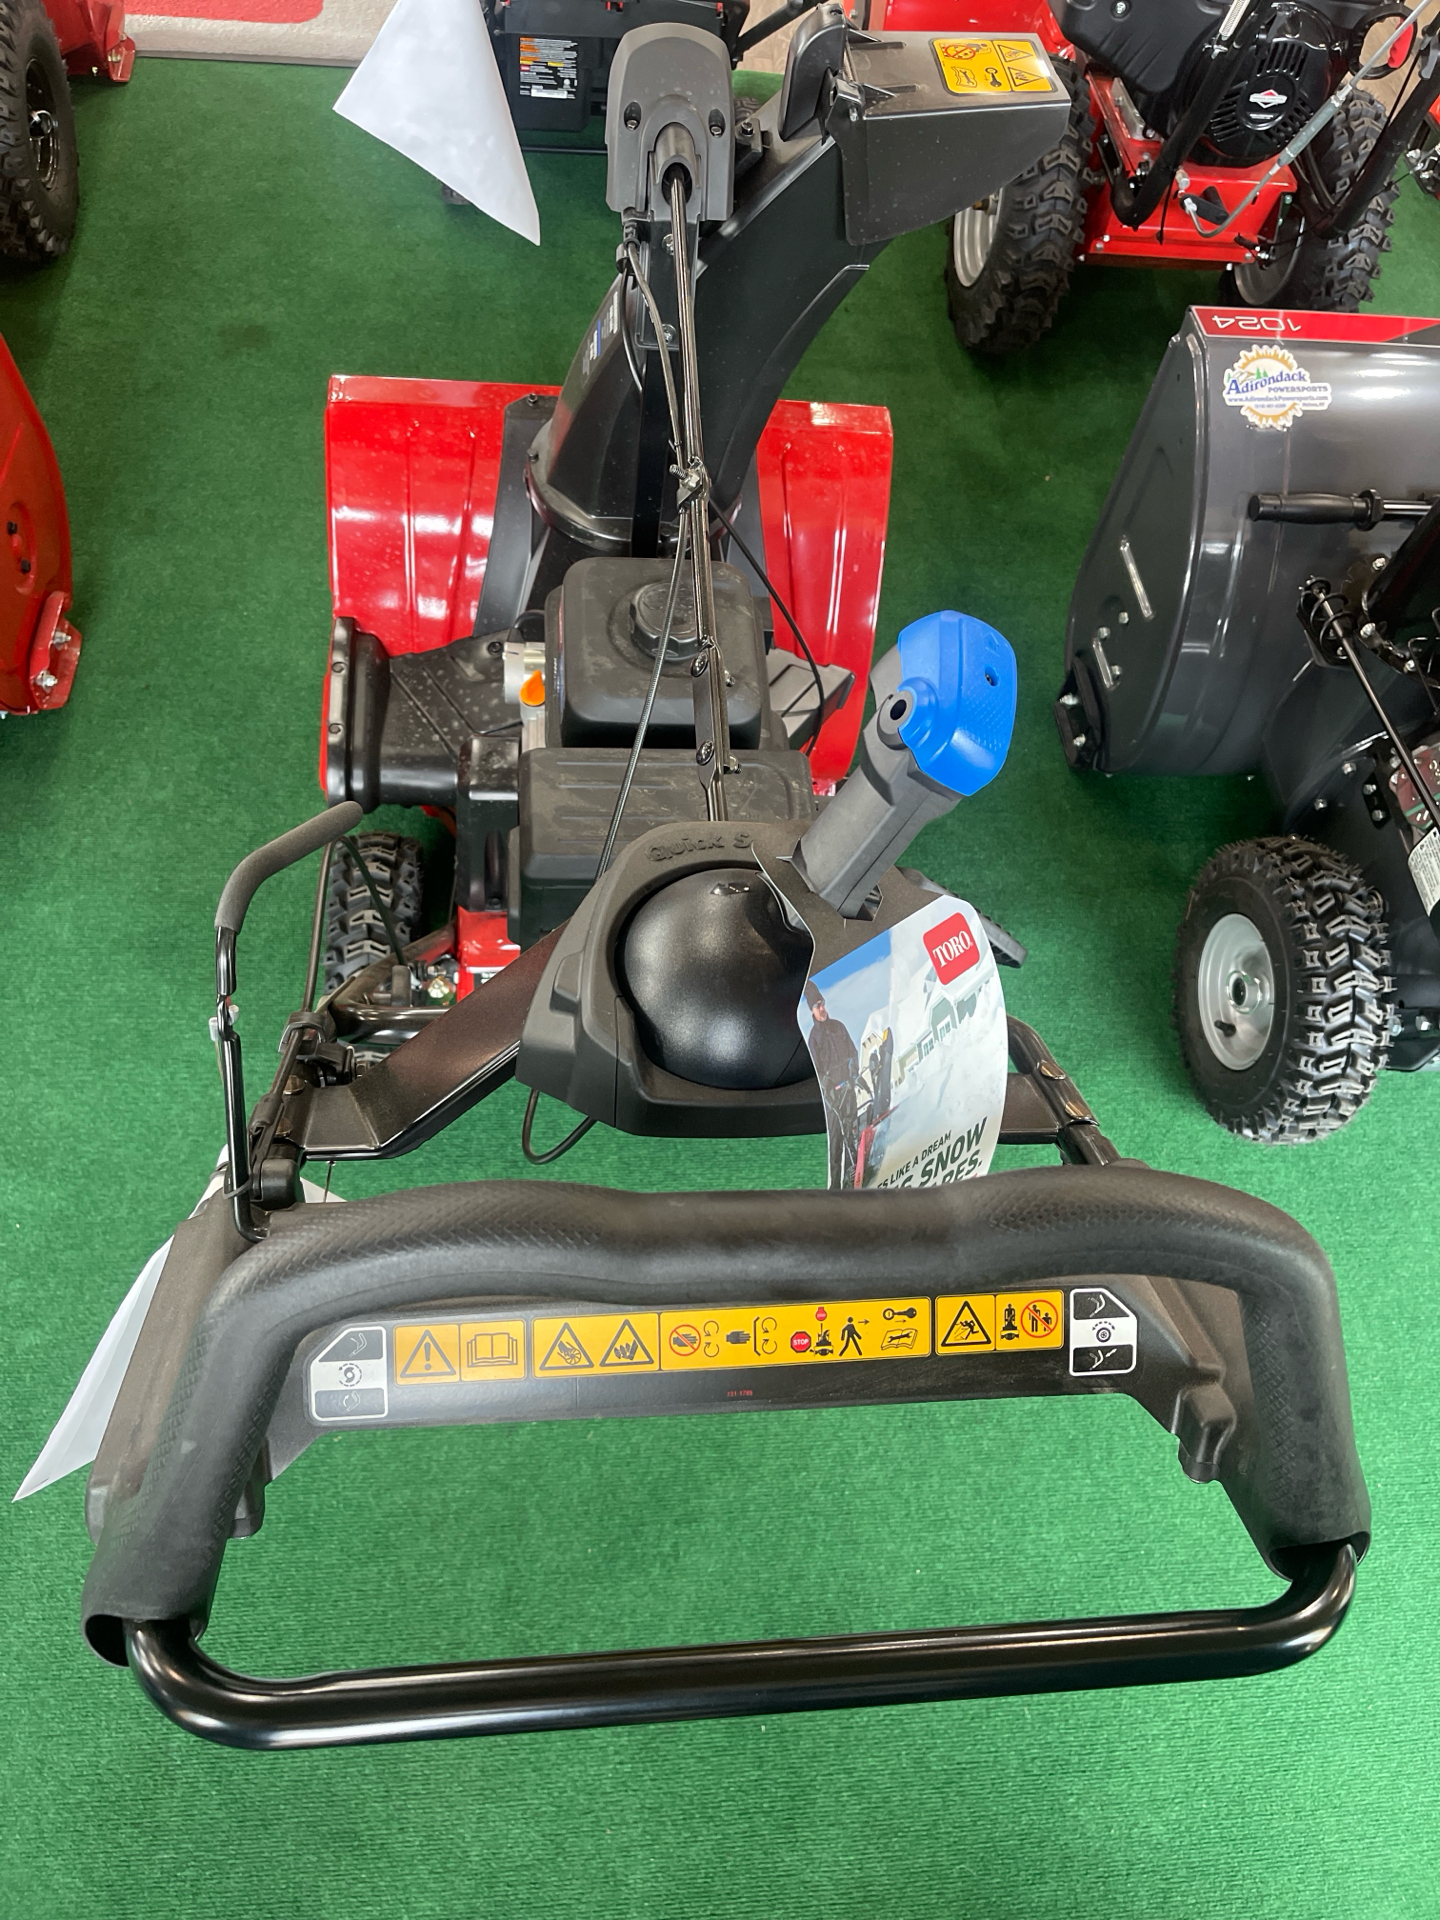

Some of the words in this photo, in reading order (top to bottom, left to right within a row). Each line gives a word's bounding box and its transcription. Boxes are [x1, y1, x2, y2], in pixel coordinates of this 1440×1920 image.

[1212, 315, 1302, 331] 1024
[1226, 370, 1307, 395] Adirondack
[1268, 385, 1328, 393] POWERSPORTS
[645, 836, 725, 861] Quick
[734, 832, 753, 849] S
[932, 931, 971, 968] TORO
[890, 1162, 911, 1184] LIKE
[912, 1155, 919, 1169] A
[921, 1130, 952, 1162] DREAM
[919, 1116, 987, 1187] SNOW
[793, 1338, 809, 1346] STOP
